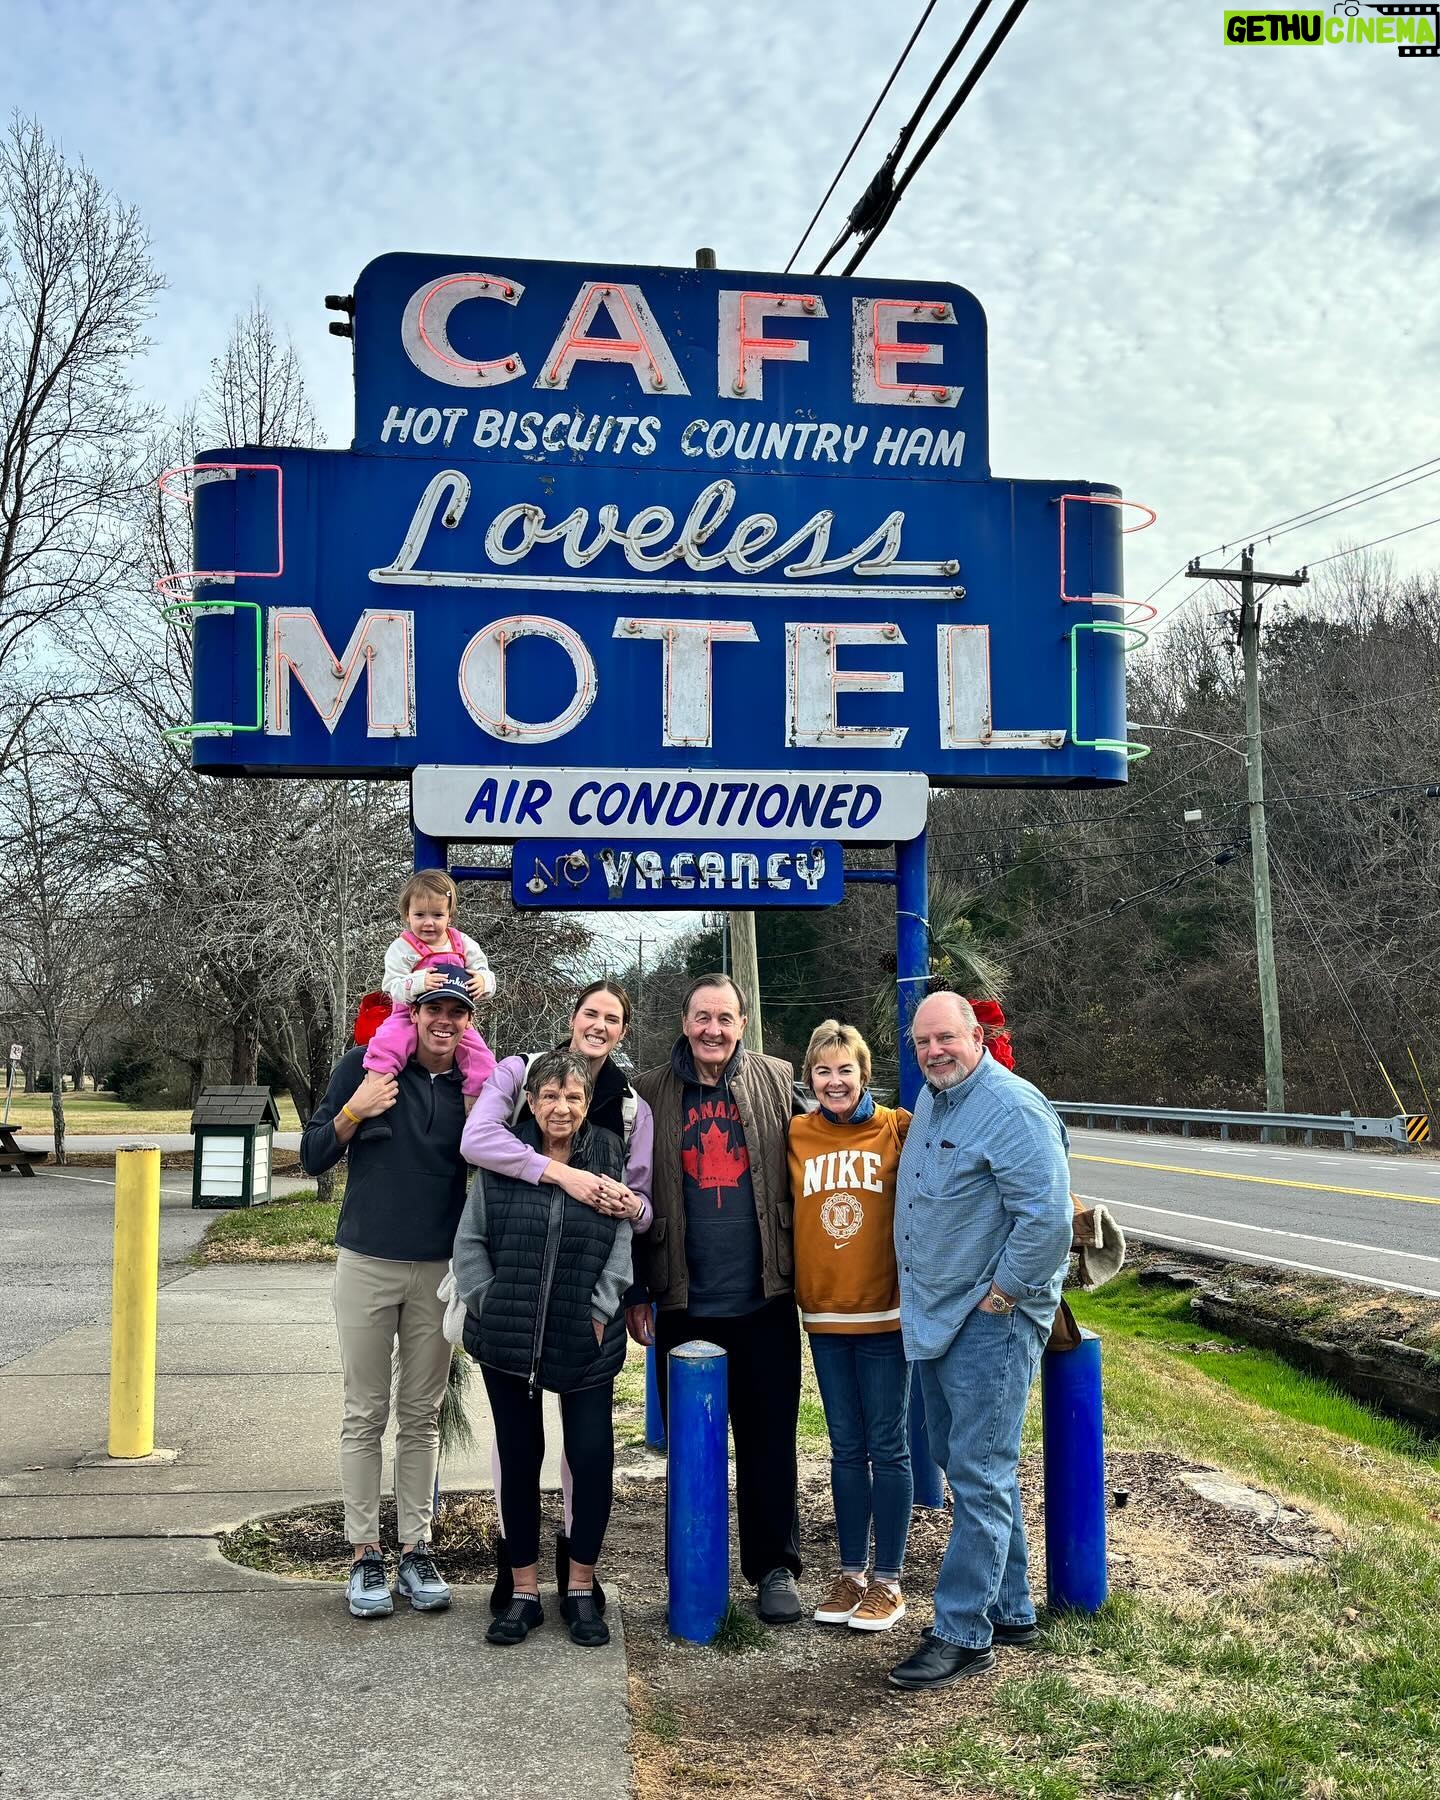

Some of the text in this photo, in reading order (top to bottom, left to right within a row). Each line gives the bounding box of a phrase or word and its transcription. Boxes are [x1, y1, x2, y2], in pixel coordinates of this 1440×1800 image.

[402, 272, 965, 408] CAFE
[381, 406, 967, 468] HOT BISCUITS COUNTRY HAM
[368, 469, 960, 586] Loveless
[263, 607, 1067, 751] MOTEL
[465, 777, 882, 829] AIR CONDITIONED
[684, 1101, 744, 1131] ANAD
[803, 1150, 883, 1198] NIKE
